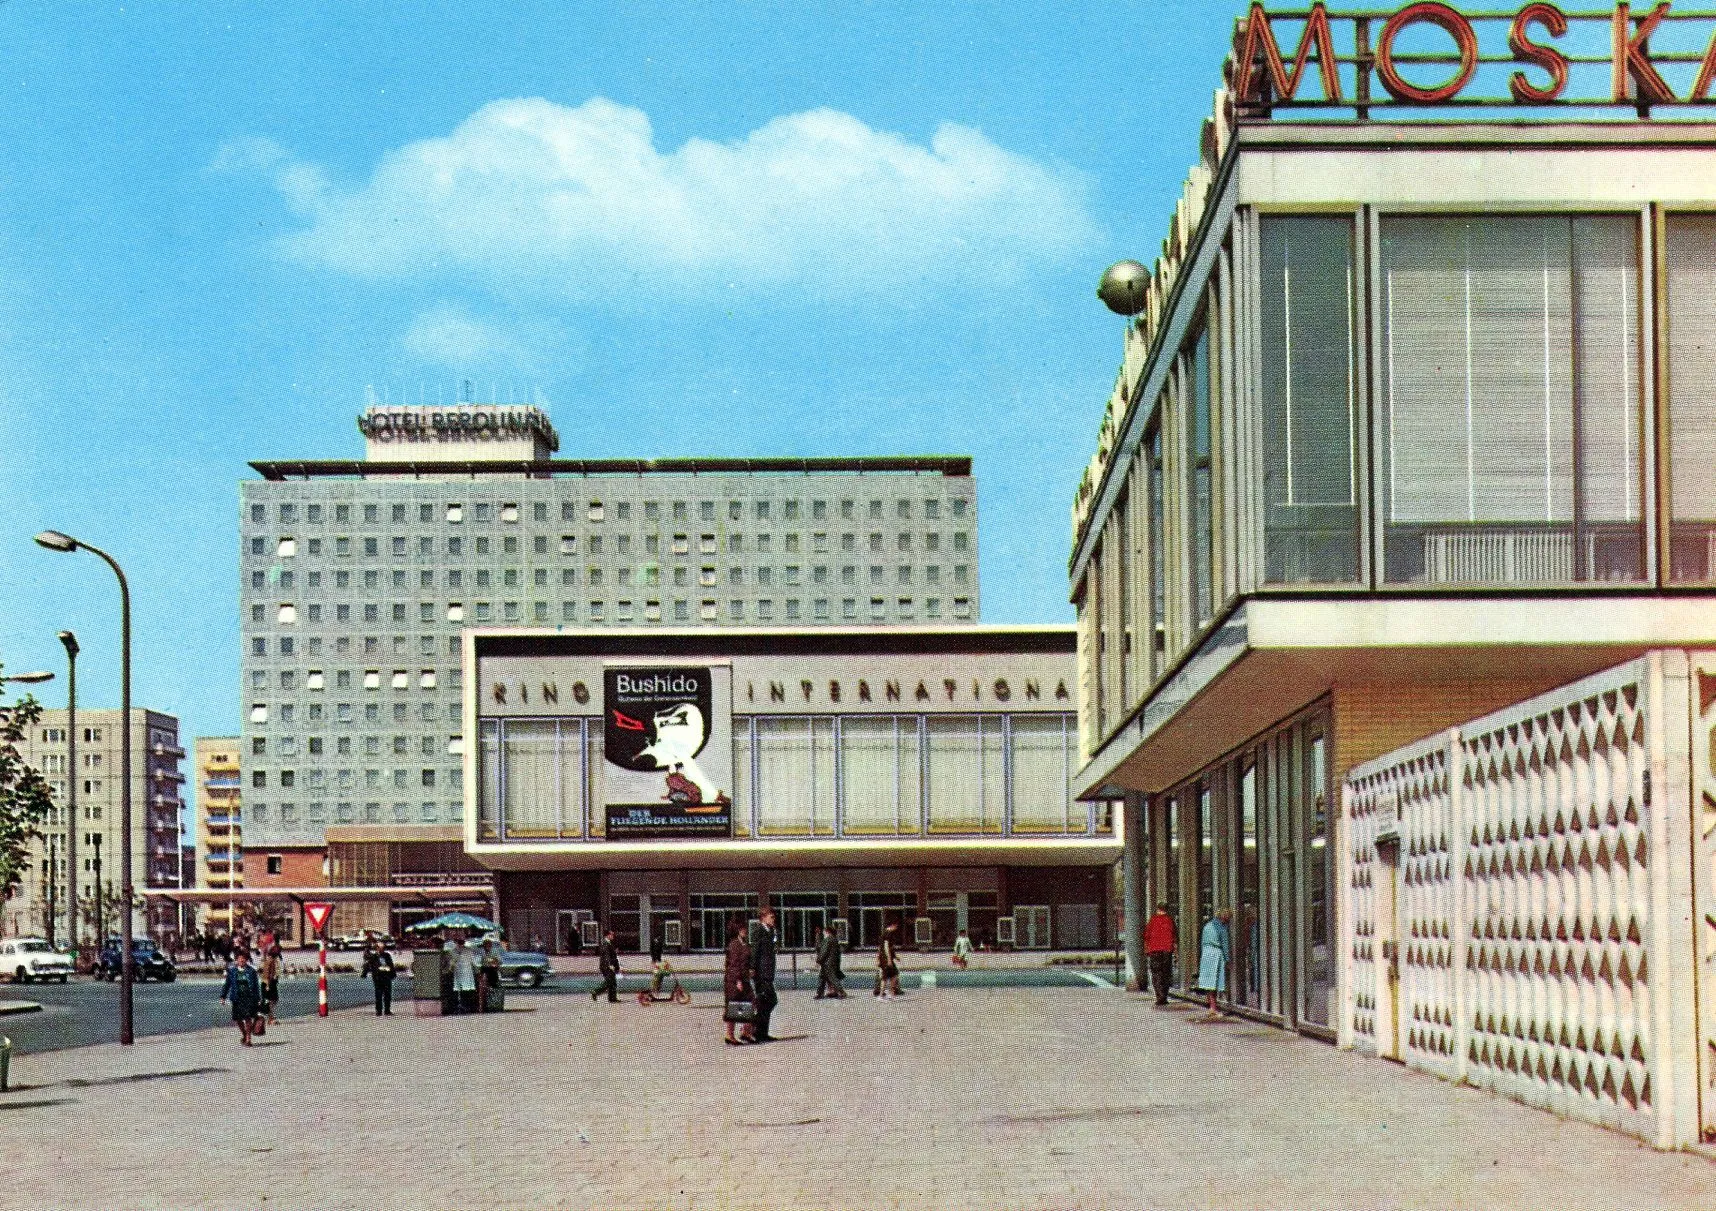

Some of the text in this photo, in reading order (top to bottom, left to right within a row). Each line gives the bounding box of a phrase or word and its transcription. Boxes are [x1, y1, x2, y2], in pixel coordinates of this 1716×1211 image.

[432, 412, 540, 430] BEROLINA
[493, 680, 590, 704] KINO
[617, 674, 698, 693] Bushido
